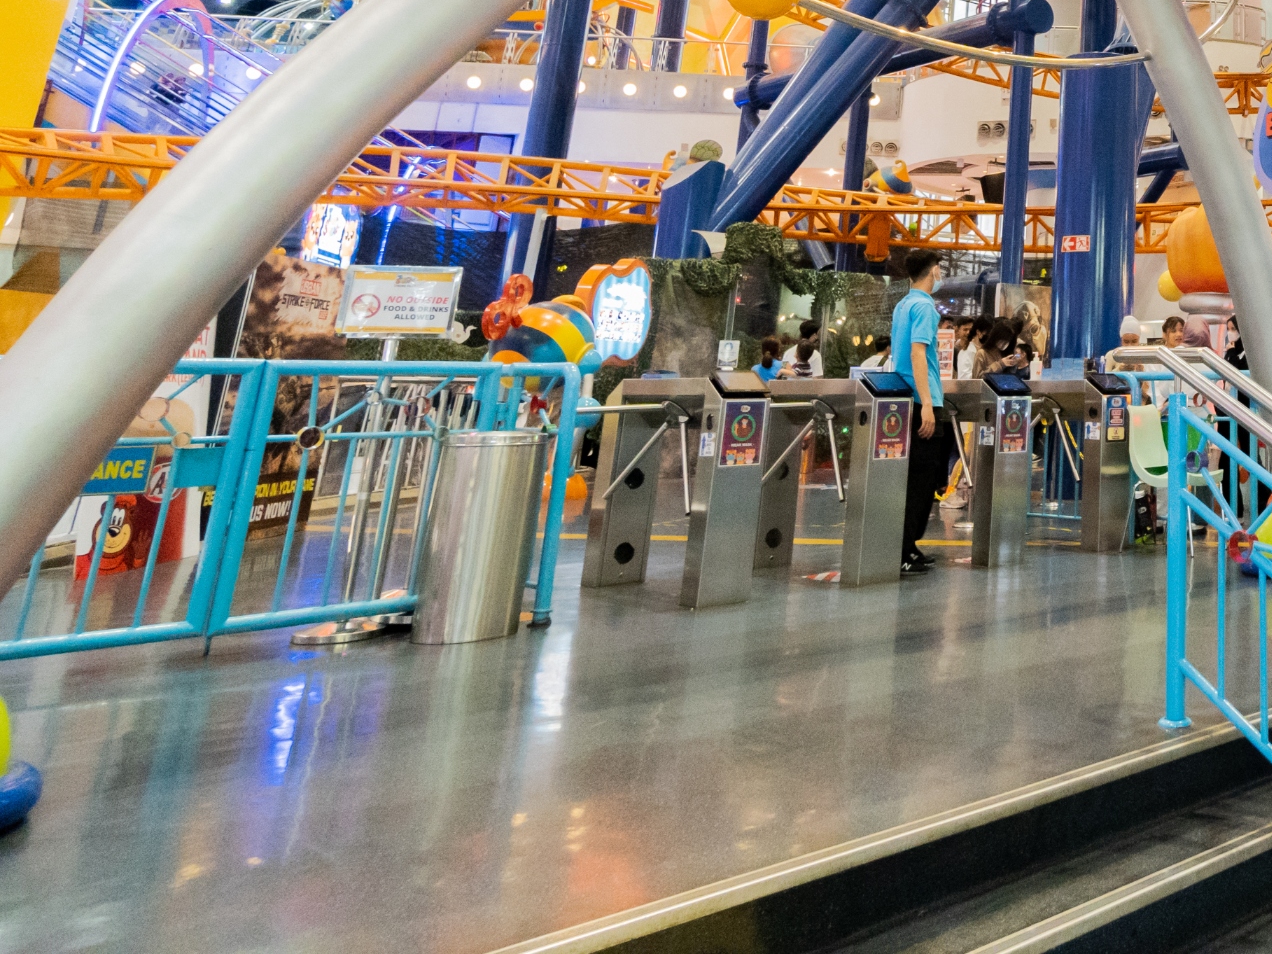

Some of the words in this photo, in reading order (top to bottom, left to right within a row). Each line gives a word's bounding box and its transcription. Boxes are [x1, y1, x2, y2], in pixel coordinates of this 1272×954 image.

[309, 297, 331, 312] FORCE
[386, 295, 403, 304] NO
[90, 459, 147, 481] ANCE
[264, 500, 292, 520] NOW!
